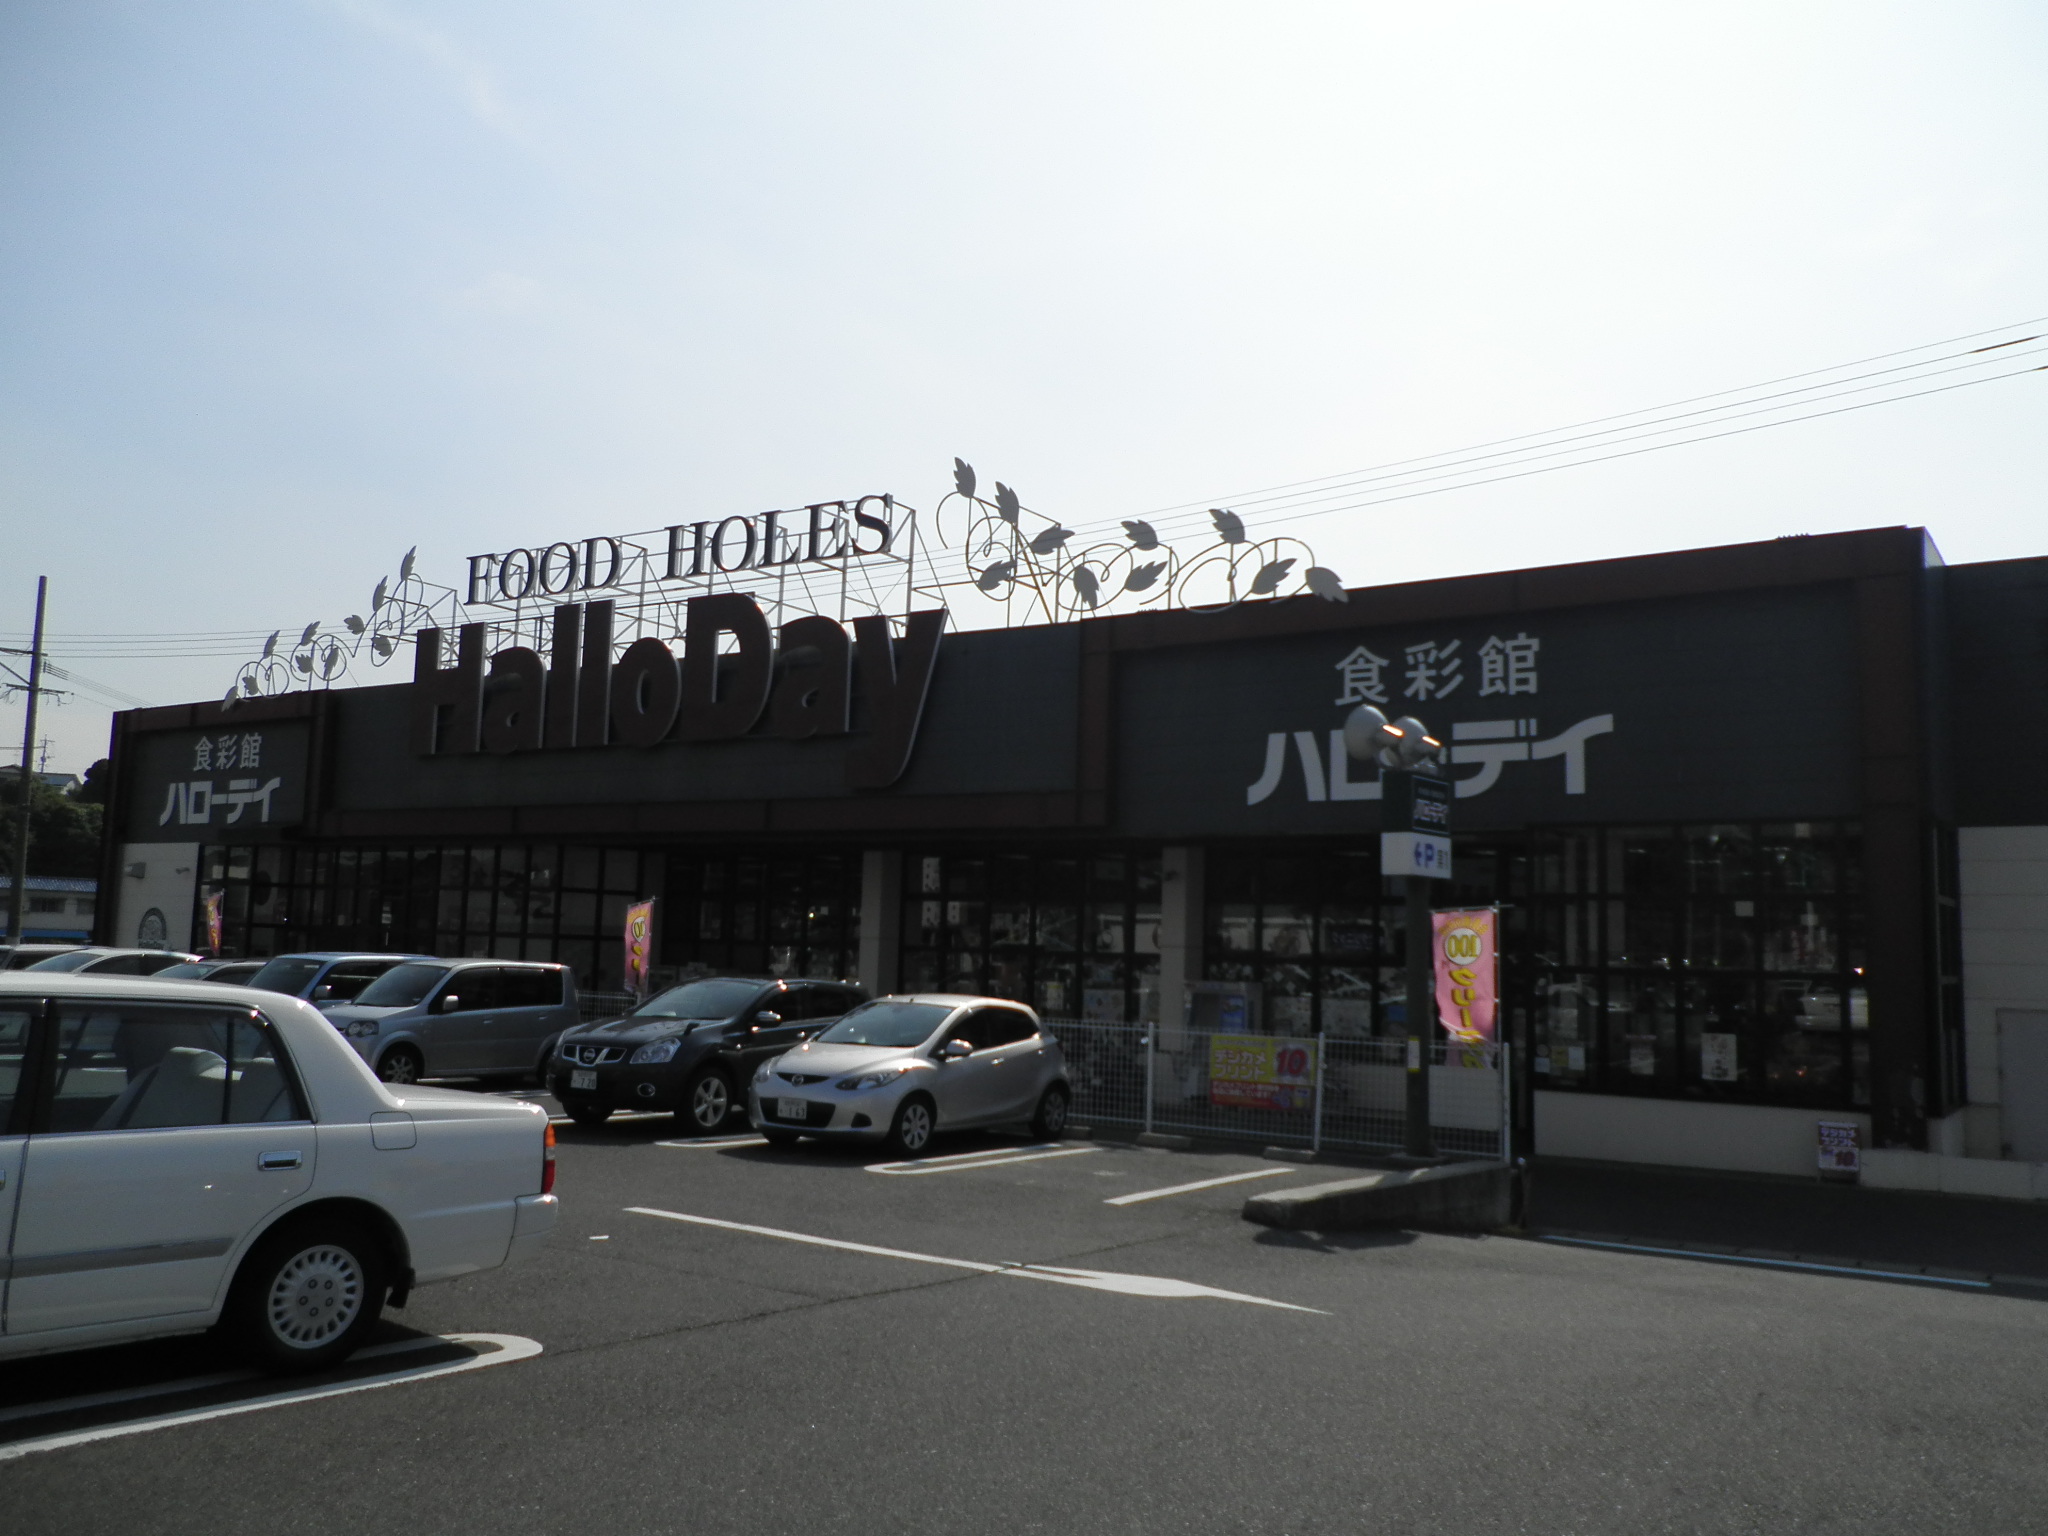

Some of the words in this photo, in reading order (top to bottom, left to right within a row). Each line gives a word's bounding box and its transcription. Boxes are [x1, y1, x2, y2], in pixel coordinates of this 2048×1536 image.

[464, 536, 622, 605] FOOD
[662, 493, 893, 580] HOLES
[1335, 632, 1541, 707] 食彩館
[193, 732, 262, 772] 食彩館
[1247, 713, 1614, 806] ハロデイ
[160, 776, 281, 826] ハローデイ
